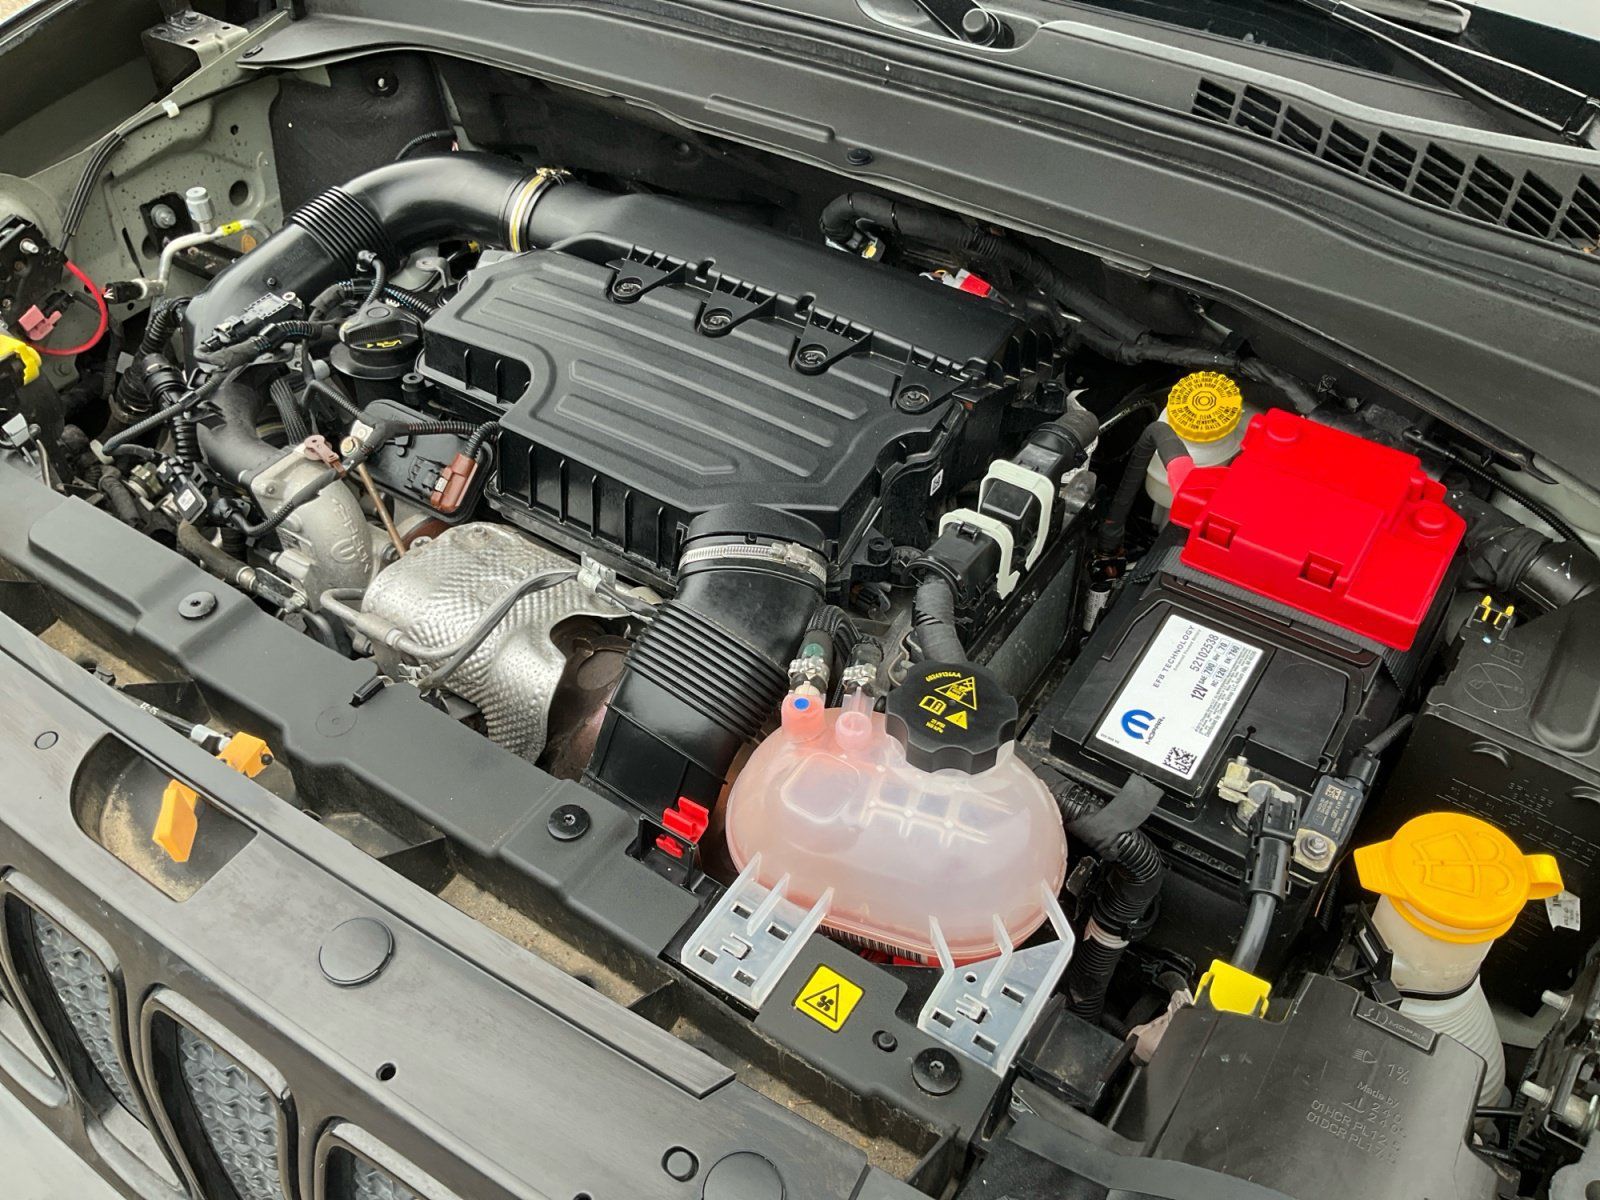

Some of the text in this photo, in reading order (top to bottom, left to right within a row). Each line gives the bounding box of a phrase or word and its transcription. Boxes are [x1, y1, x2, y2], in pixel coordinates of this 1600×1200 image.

[1153, 625, 1194, 688] EFB TECHNOLOGY
[1190, 634, 1219, 672] 52102538
[1191, 684, 1208, 701] 12V
[1204, 662, 1215, 675] 700
[1215, 668, 1226, 680] 120
[1357, 1082, 1384, 1100] Made
